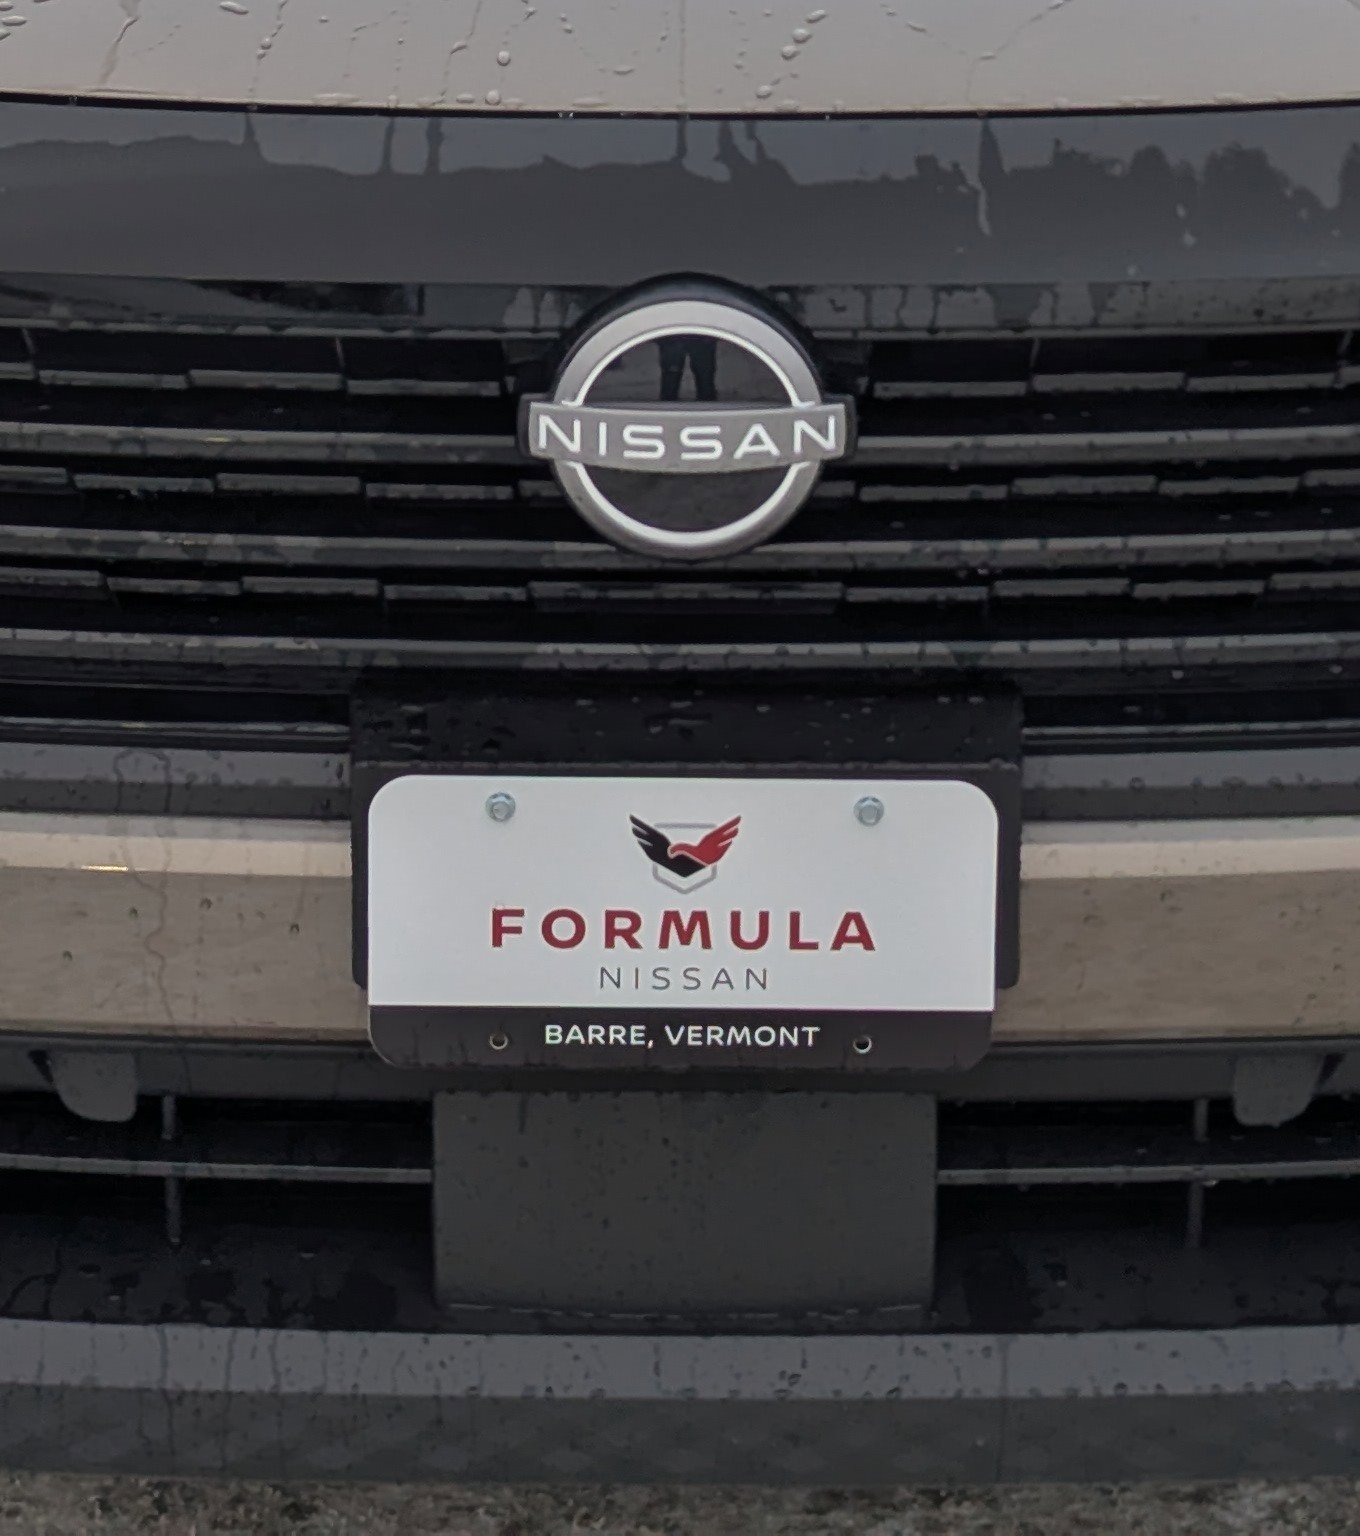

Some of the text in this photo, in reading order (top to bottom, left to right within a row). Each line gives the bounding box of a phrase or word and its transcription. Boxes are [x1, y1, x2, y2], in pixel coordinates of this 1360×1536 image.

[539, 414, 836, 460] NISSAN
[490, 907, 877, 952] FORMULA
[599, 966, 769, 991] NISSAN
[544, 1024, 820, 1050] BARRE, VERMONT
